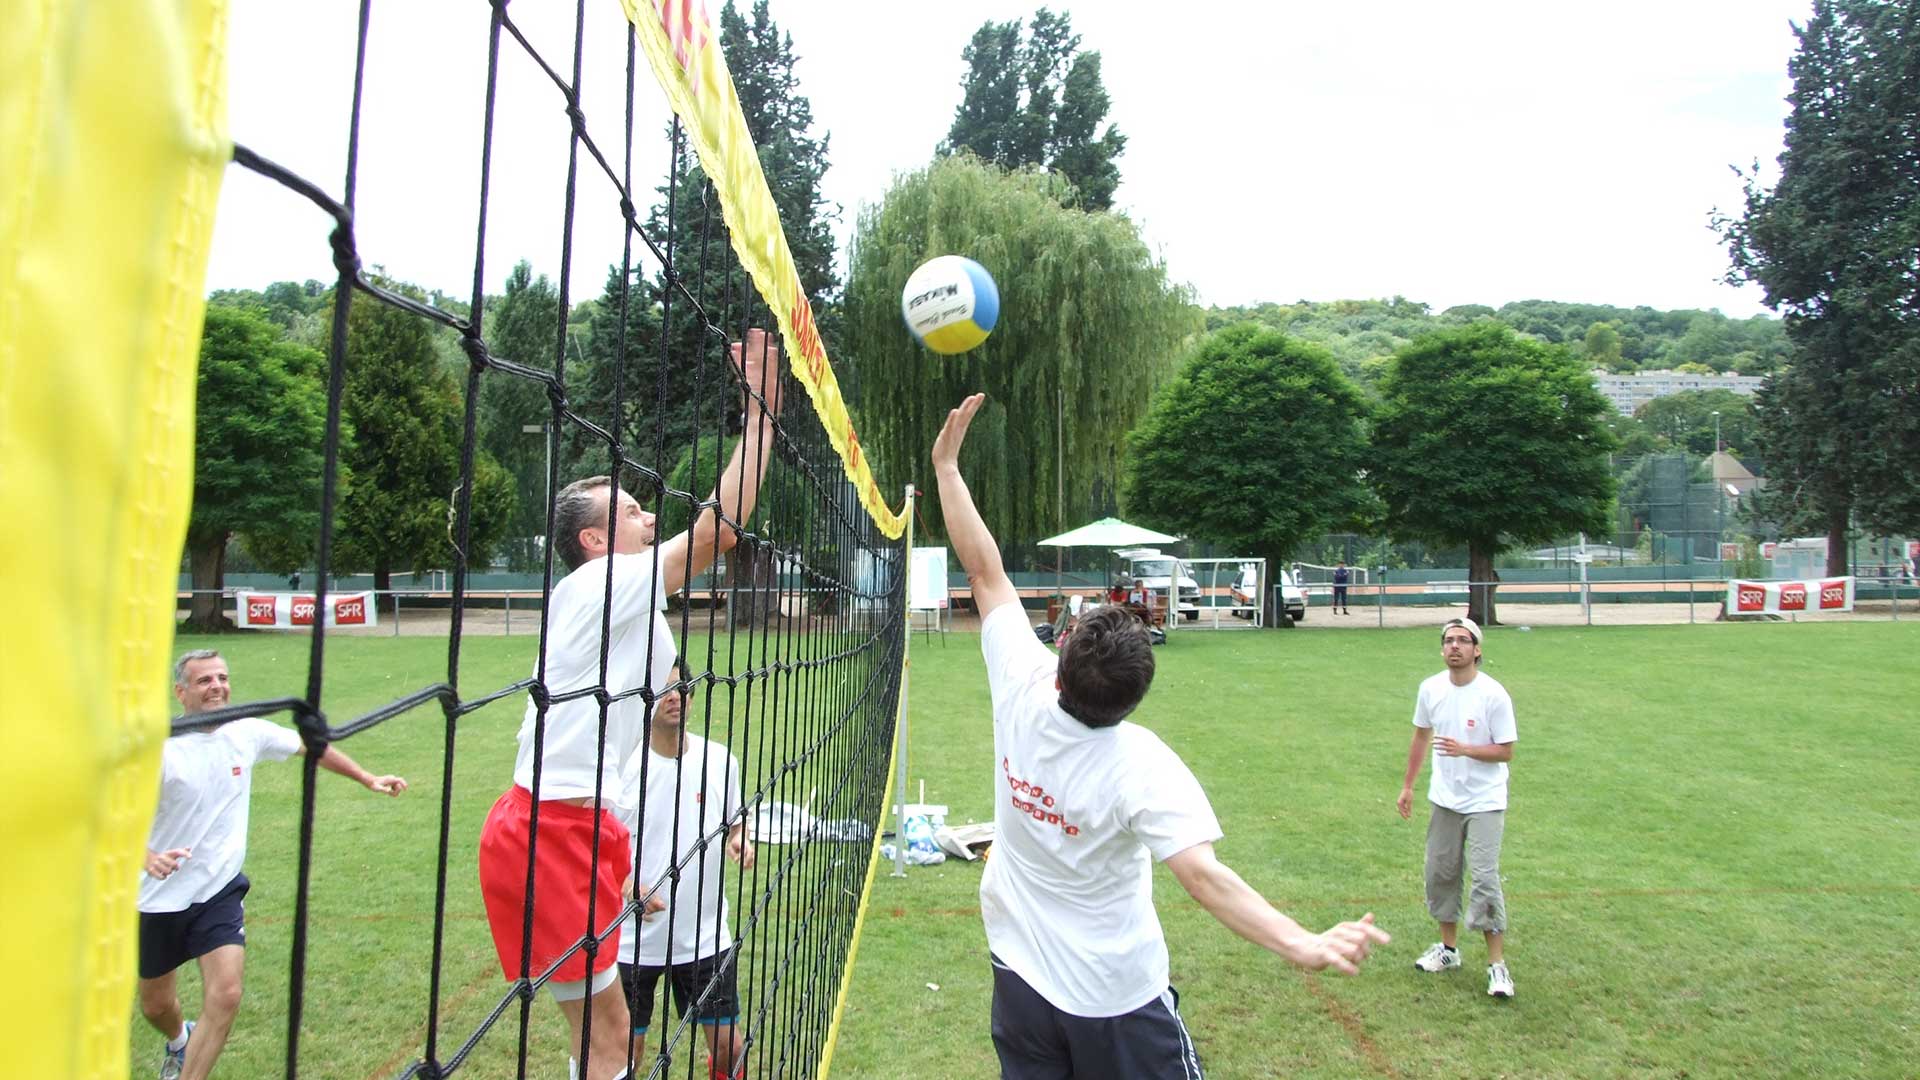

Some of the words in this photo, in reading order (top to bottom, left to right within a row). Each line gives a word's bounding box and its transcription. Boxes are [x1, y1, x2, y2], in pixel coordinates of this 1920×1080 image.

[1740, 591, 1763, 604] SFR
[1782, 590, 1804, 604] SFR
[1823, 588, 1843, 602] SFR
[250, 603, 273, 618] SFR
[293, 604, 315, 618] SFR
[338, 602, 362, 618] SFR
